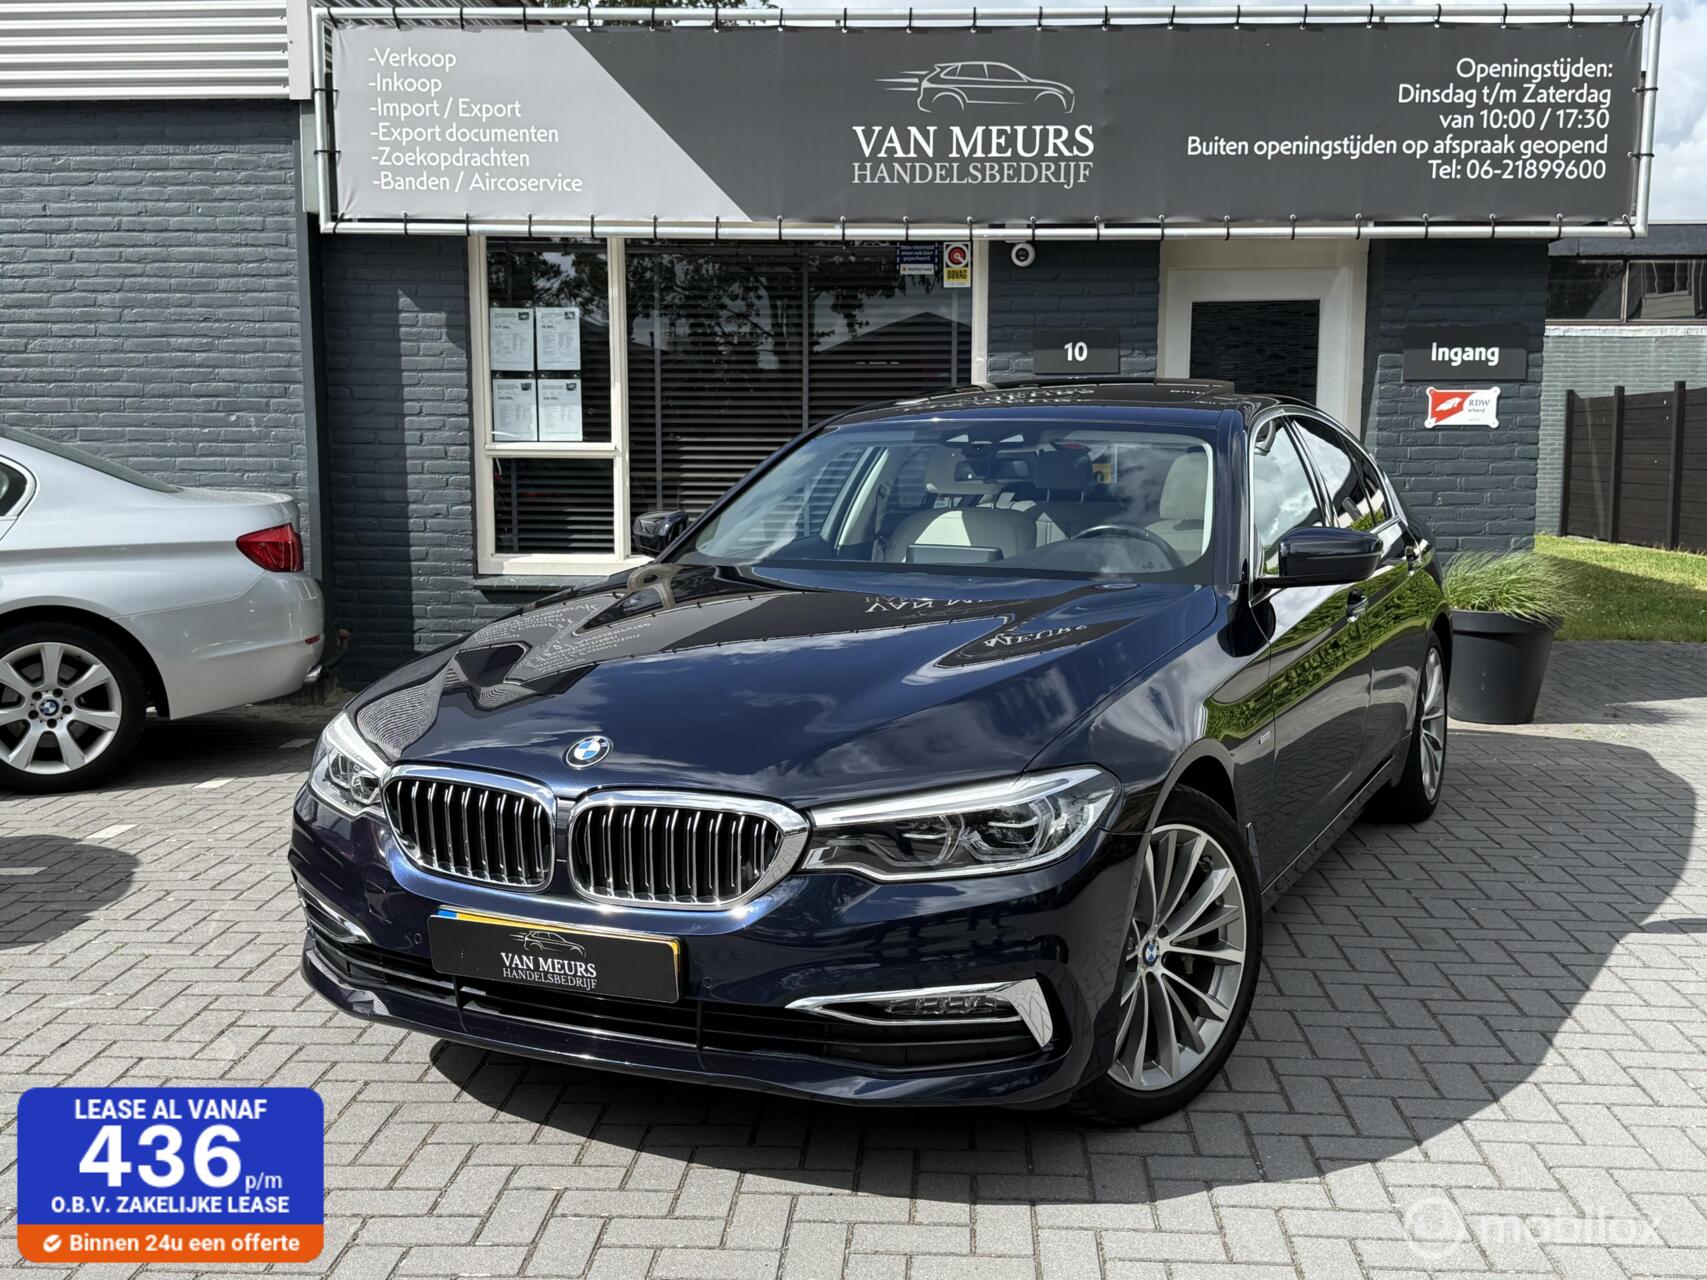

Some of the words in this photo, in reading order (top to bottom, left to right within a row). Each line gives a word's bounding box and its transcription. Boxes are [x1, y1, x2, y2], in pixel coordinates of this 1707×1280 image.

[367, 48, 457, 72] -Verkoop
[1456, 57, 1613, 82] Openingstijden:
[368, 73, 442, 96] -Inkoop
[1398, 83, 1477, 108] Dinsdag
[1482, 84, 1517, 105] t/m
[1522, 83, 1612, 108] Zaterdag
[369, 98, 440, 120] -Import
[443, 97, 454, 119] /
[458, 99, 522, 122] Export
[1440, 113, 1474, 129] van
[1480, 109, 1535, 129] 10:00
[1540, 109, 1550, 131] /
[1556, 109, 1610, 129] 17:30
[370, 123, 442, 146] -Export
[445, 123, 559, 144] documenten
[852, 125, 938, 158] VAN
[949, 124, 1095, 158] MEURS
[1187, 136, 1249, 156] Buiten
[1254, 135, 1397, 159] openingstijden
[1402, 140, 1429, 159] op
[1433, 134, 1515, 158] afspraak
[1520, 134, 1608, 158] geopend
[371, 147, 530, 171] -Zoekopdrachten
[1428, 159, 1462, 179] Tel:
[1466, 159, 1606, 180] 06-21899600
[372, 171, 450, 191] -Banden
[454, 170, 464, 193] /
[468, 172, 583, 192] Aircoservice
[851, 161, 1094, 189] HANDELSBEDRIJF
[946, 269, 968, 280] BOVAG
[1063, 341, 1088, 362] 10
[1431, 342, 1500, 367] Ingang
[1469, 399, 1490, 407] RDW
[500, 952, 534, 971] VAN
[538, 956, 597, 978] MEURS
[502, 967, 597, 991] HANDELSBEDRIJF
